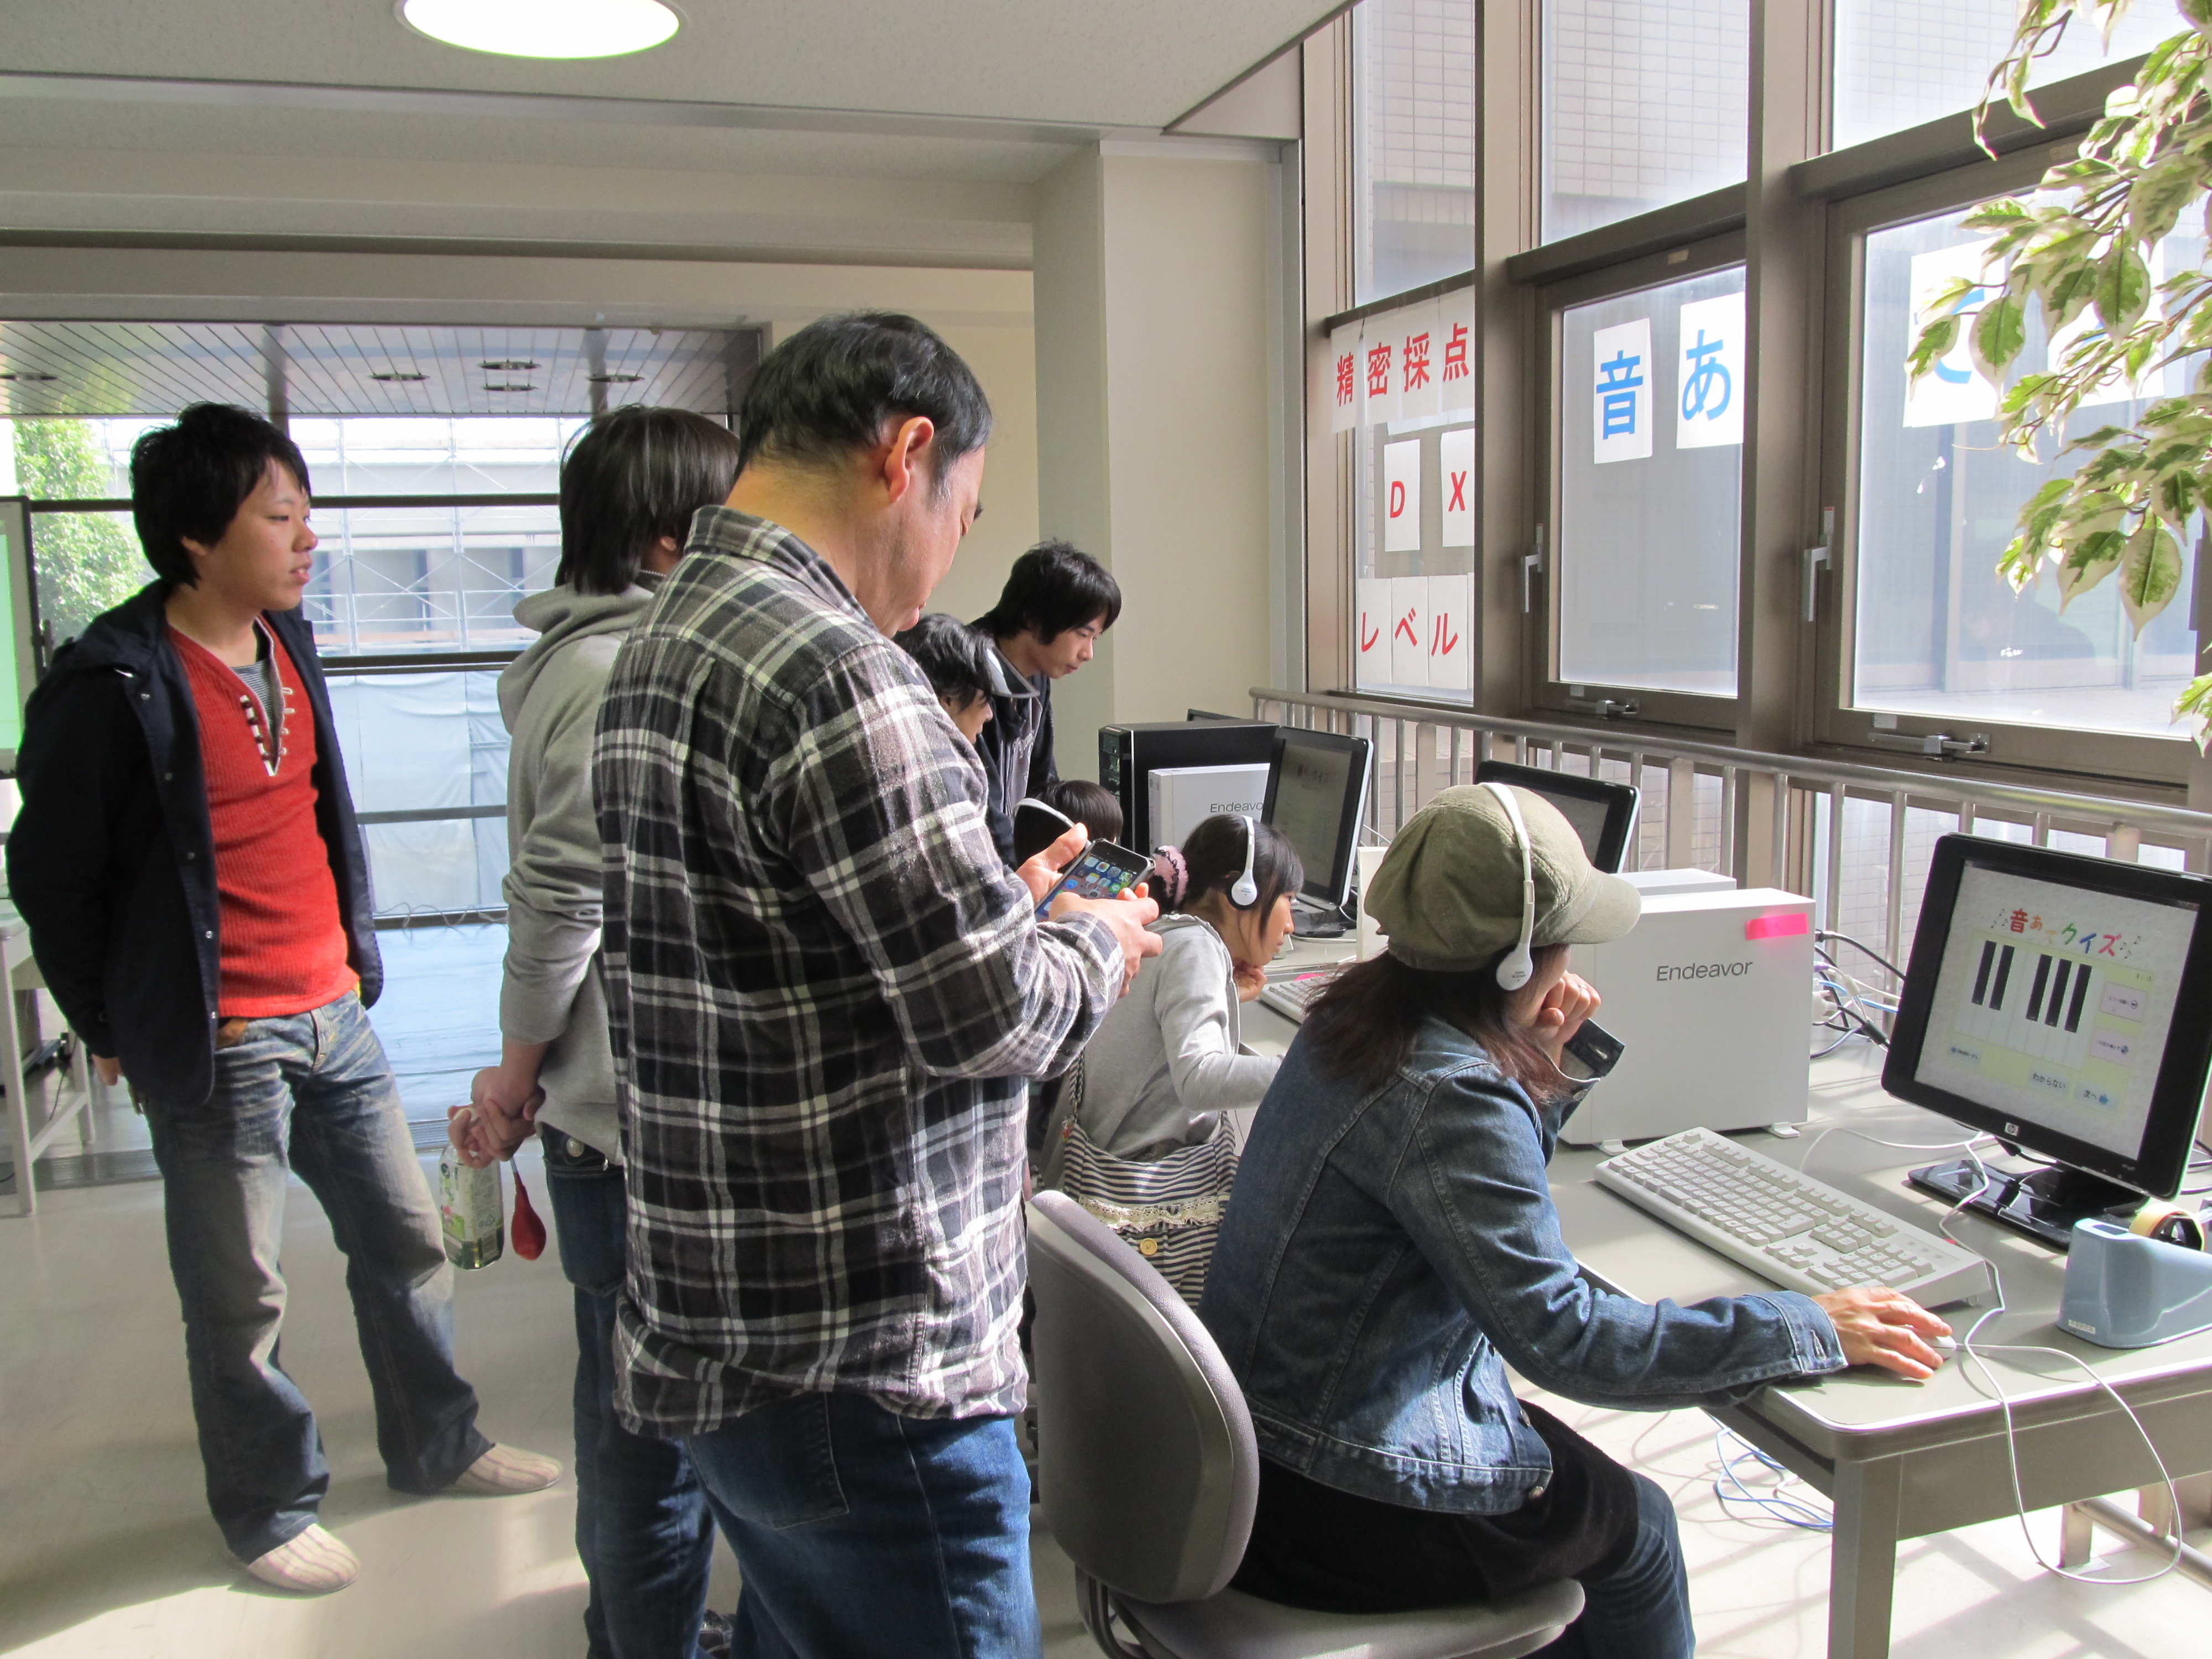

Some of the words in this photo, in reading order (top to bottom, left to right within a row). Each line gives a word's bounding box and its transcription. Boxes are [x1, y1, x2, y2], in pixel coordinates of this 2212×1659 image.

[1336, 322, 1470, 407] 精密採点
[1361, 607, 1458, 656] レベル
[1210, 802, 1264, 813] Endeavo
[2010, 907, 2122, 957] 音あてクイズ
[1657, 961, 1753, 981] Endeavor
